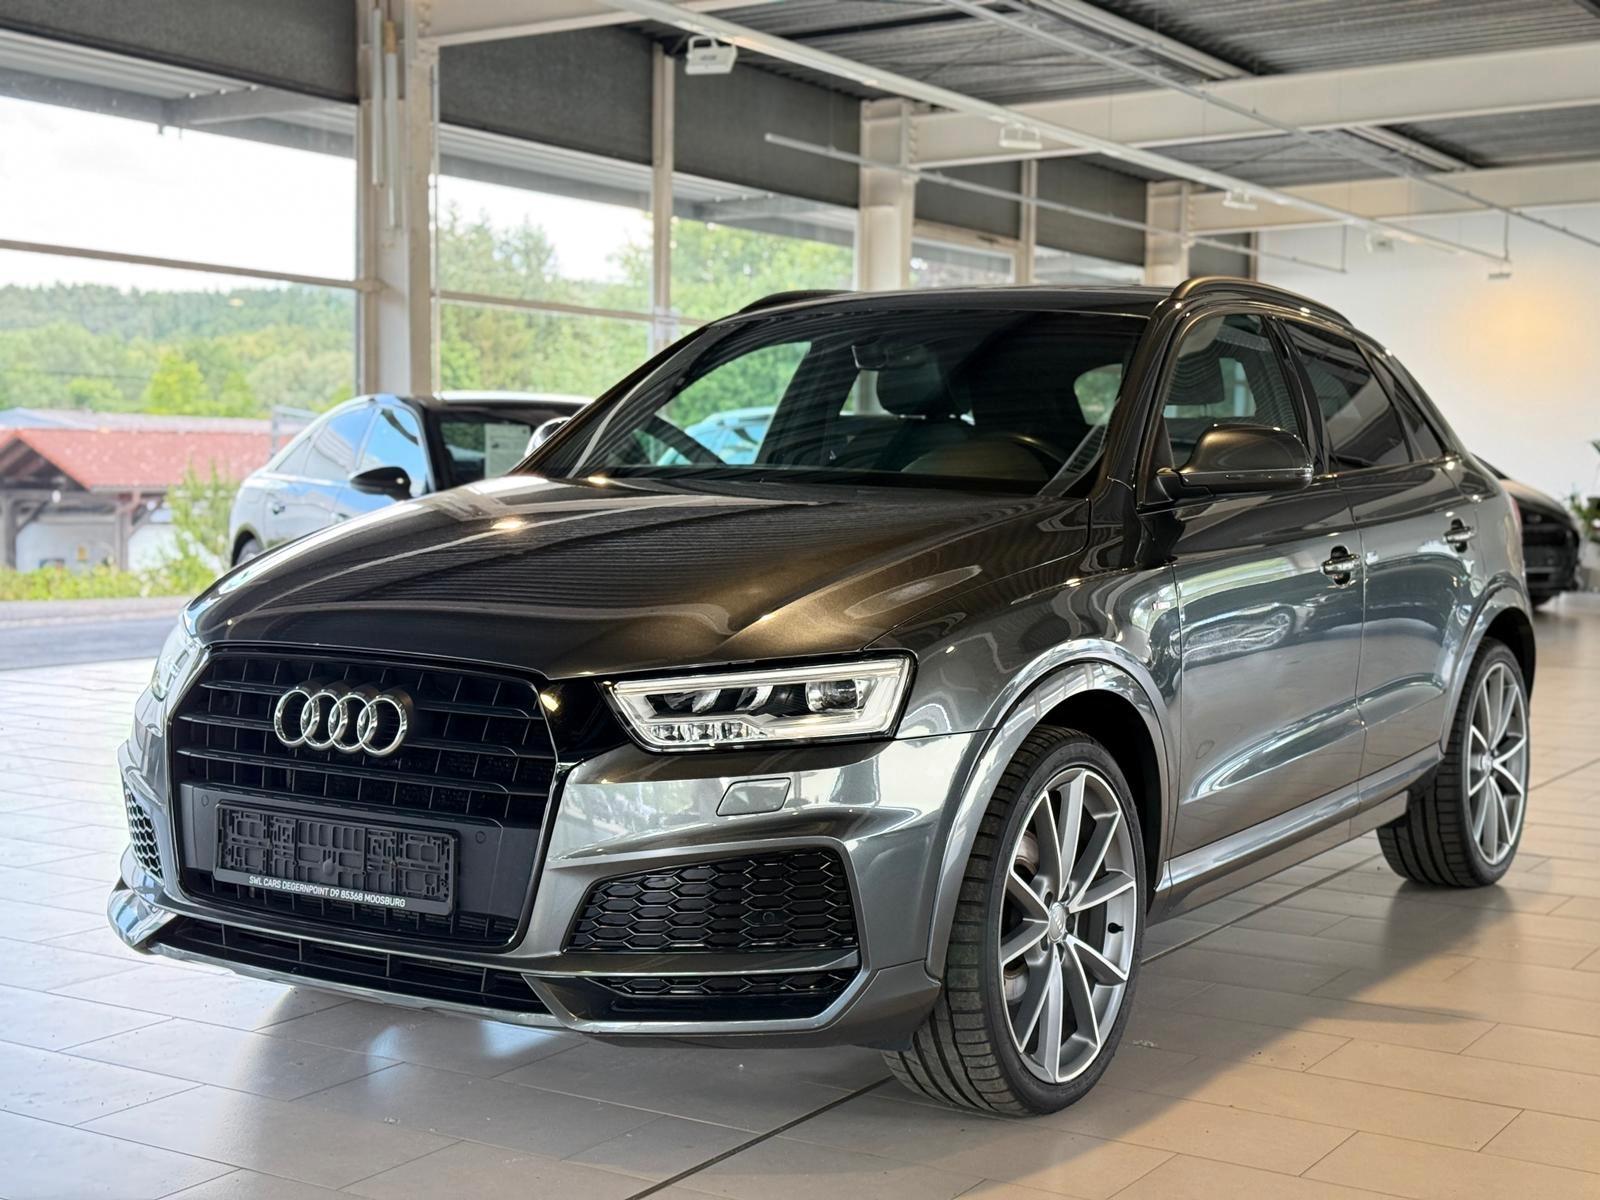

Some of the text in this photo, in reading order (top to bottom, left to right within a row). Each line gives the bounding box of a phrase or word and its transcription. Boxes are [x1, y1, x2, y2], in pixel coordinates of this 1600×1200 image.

[249, 875, 262, 886] SWL
[263, 878, 281, 889] CARS
[282, 881, 329, 896] DEGERNPOINT
[340, 890, 363, 901] 85368
[364, 893, 406, 907] MOOSBURG
